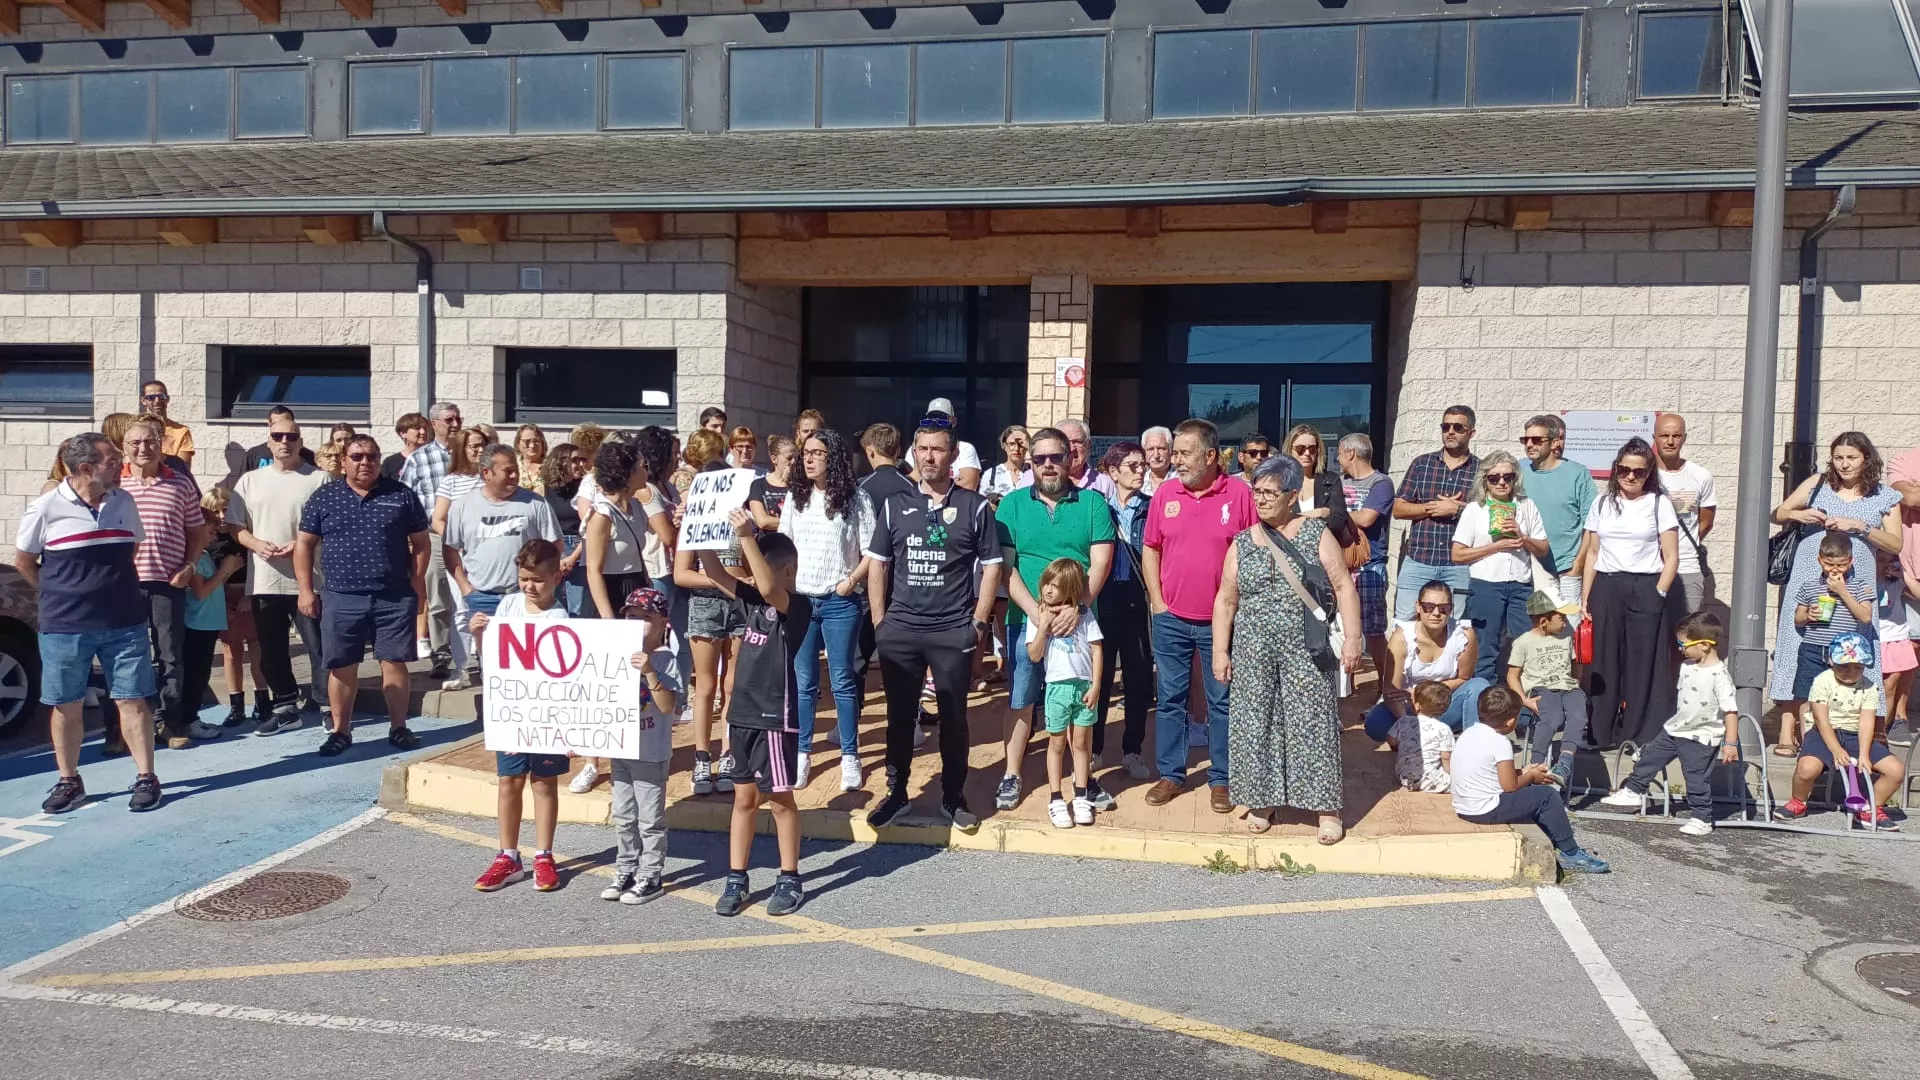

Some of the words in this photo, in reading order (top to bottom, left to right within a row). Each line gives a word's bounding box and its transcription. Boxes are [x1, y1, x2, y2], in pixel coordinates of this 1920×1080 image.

[692, 476, 709, 496] NO
[712, 473, 736, 494] NOS
[685, 500, 706, 517] VAN
[708, 499, 717, 514] A
[906, 533, 923, 547] de
[907, 546, 946, 561] buena
[908, 560, 938, 574] tinta
[499, 623, 582, 678] NO
[581, 653, 598, 677] A
[604, 653, 629, 680] LA
[489, 676, 592, 703] REDUCCIÓN
[596, 684, 620, 703] DE
[491, 704, 524, 723] LOS
[528, 706, 614, 725] CURSILLOS
[615, 707, 638, 723] DE
[517, 726, 625, 750] NATACIÓN
